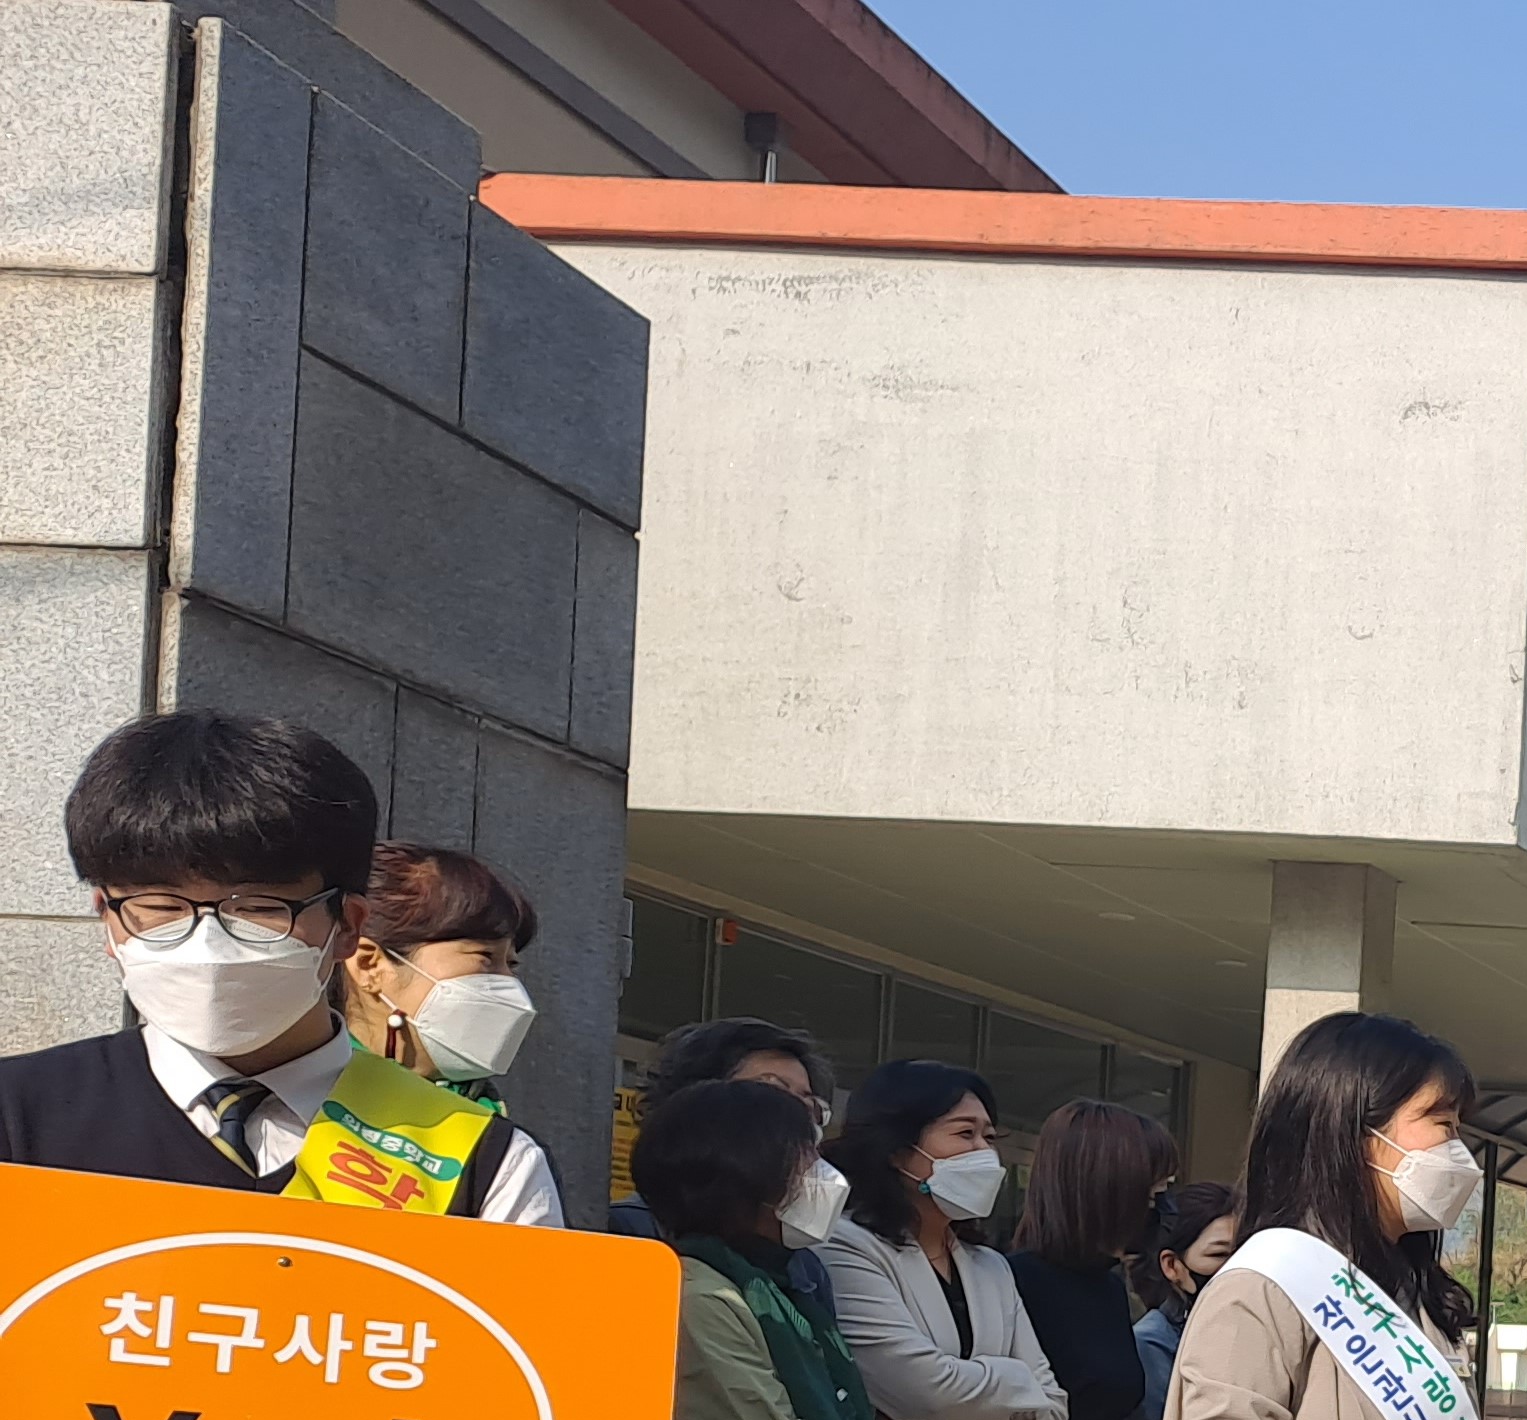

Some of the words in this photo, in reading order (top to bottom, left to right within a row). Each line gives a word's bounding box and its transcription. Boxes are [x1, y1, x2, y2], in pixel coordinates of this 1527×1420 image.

[341, 1112, 443, 1176] 의령중학교
[97, 1290, 437, 1391] 친구사랑
[1331, 1267, 1457, 1414] 친구사랑
